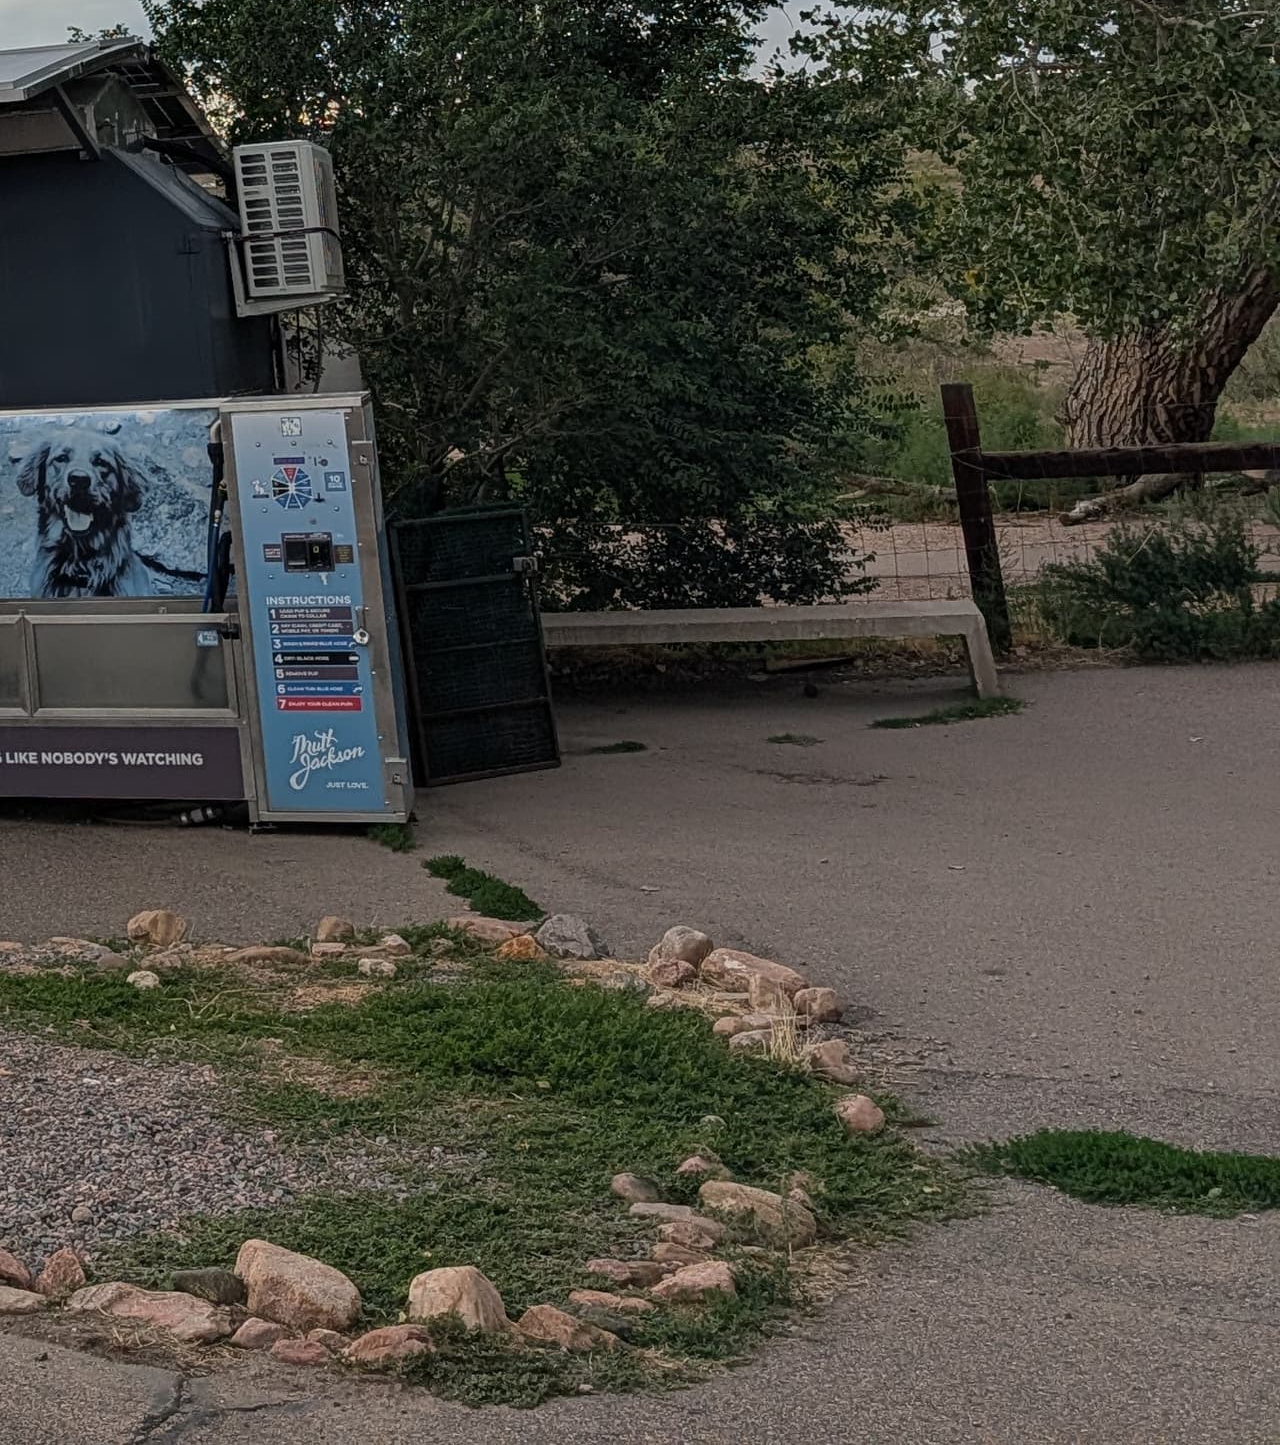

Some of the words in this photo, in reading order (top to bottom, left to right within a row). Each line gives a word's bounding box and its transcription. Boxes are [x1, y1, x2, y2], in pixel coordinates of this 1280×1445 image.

[329, 475, 340, 483] 10
[266, 595, 351, 605] INSTRUCTIONS
[270, 609, 276, 619] 1
[271, 624, 279, 634] 2
[273, 639, 281, 649] 3
[274, 654, 283, 663] 4
[276, 669, 284, 679] 5
[277, 684, 286, 694] 6
[278, 699, 286, 709] 7
[289, 728, 338, 764] Mutt
[6, 752, 38, 764] LIKE
[41, 752, 118, 765] NOBODY'S
[120, 752, 204, 765] WATCHING
[289, 746, 366, 790] Jackson
